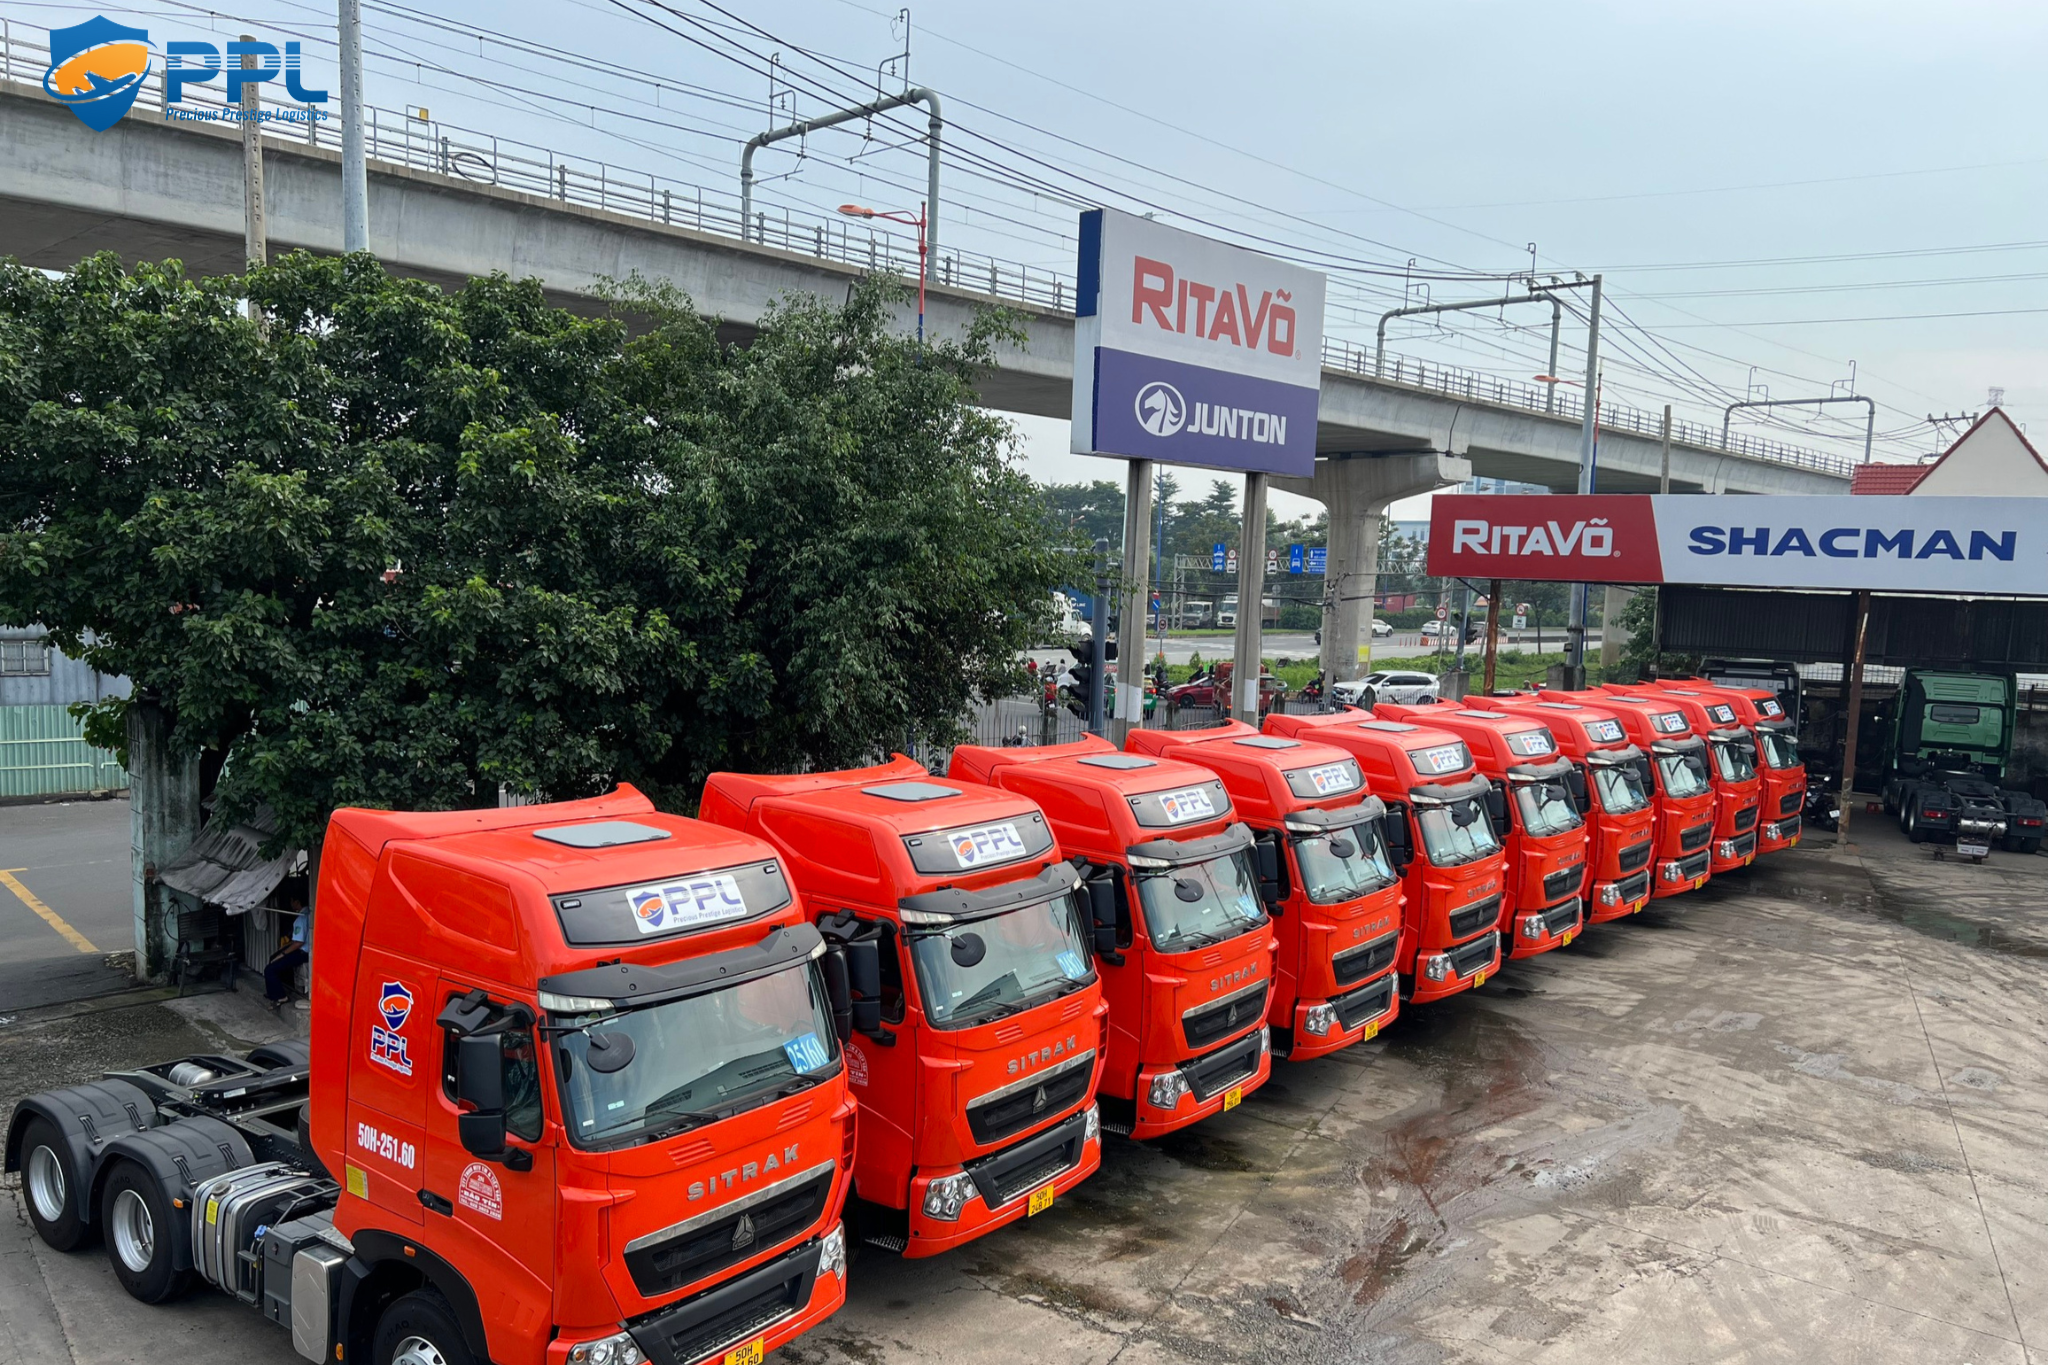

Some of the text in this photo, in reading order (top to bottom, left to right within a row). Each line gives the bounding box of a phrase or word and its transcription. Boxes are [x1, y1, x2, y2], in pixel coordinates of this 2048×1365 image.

[1186, 401, 1287, 446] JUNTON
[1687, 525, 2017, 561] SHACMAN
[1436, 748, 1460, 765] PPL
[1321, 767, 1350, 785] PPL
[1174, 790, 1211, 812] PPL
[970, 826, 1022, 854] PPL
[662, 880, 741, 915] PPL
[673, 914, 698, 924] Precious
[698, 910, 721, 920] Prestige
[1210, 961, 1257, 992] SITRAK
[371, 1025, 412, 1067] PPL
[786, 1036, 828, 1074] 25160
[1007, 1034, 1076, 1074] SITRAK
[358, 1121, 415, 1169] 50H-251.60
[687, 1143, 799, 1201] SITRAK
[736, 1343, 753, 1362] 50H
